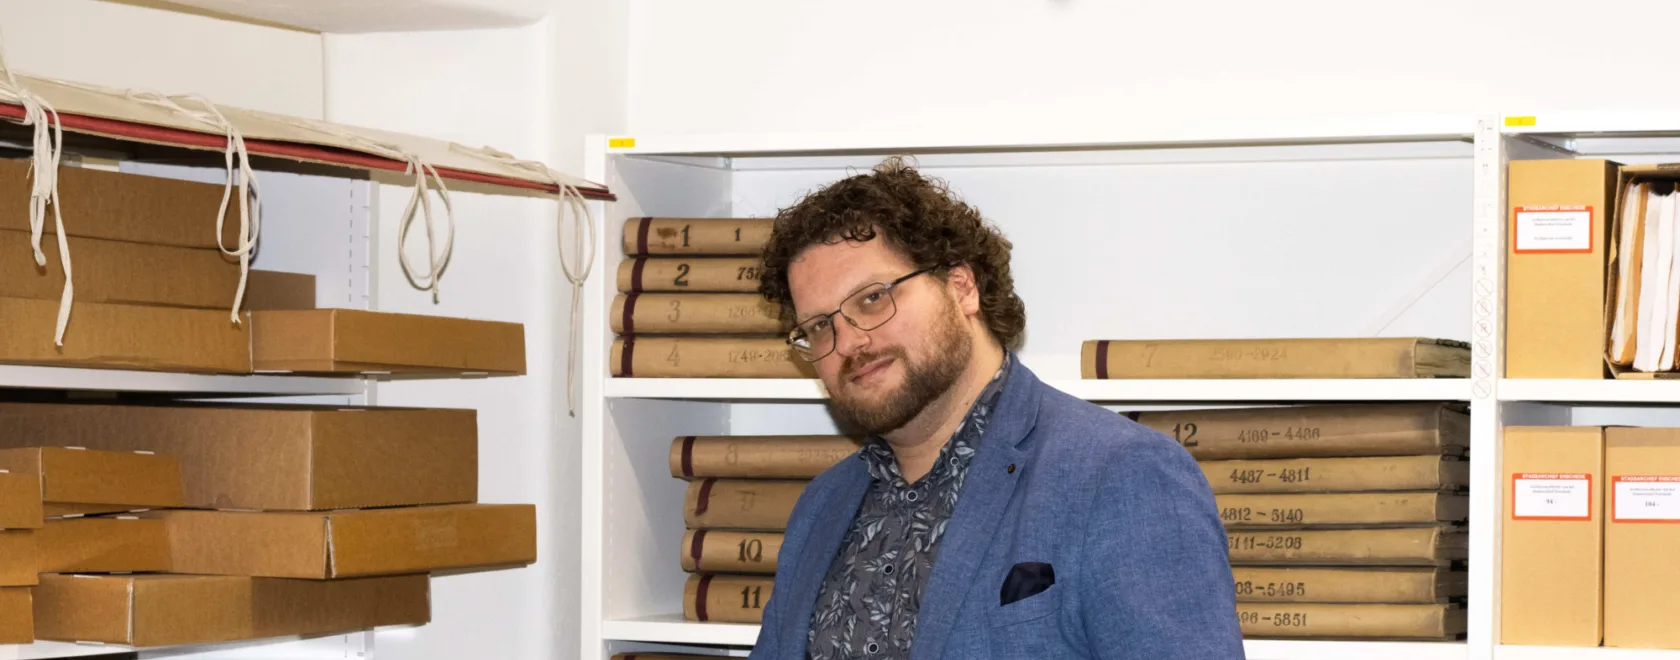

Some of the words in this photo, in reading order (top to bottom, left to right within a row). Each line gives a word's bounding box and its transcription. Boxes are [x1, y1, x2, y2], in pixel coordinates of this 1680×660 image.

[680, 224, 690, 247] 1
[735, 228, 741, 241] 1
[674, 264, 690, 286] 2
[667, 300, 681, 323] 3
[667, 343, 680, 367] 4
[1142, 343, 1159, 367] 7
[1172, 422, 1198, 447] 12
[737, 539, 763, 563] 10
[741, 585, 761, 609] 11
